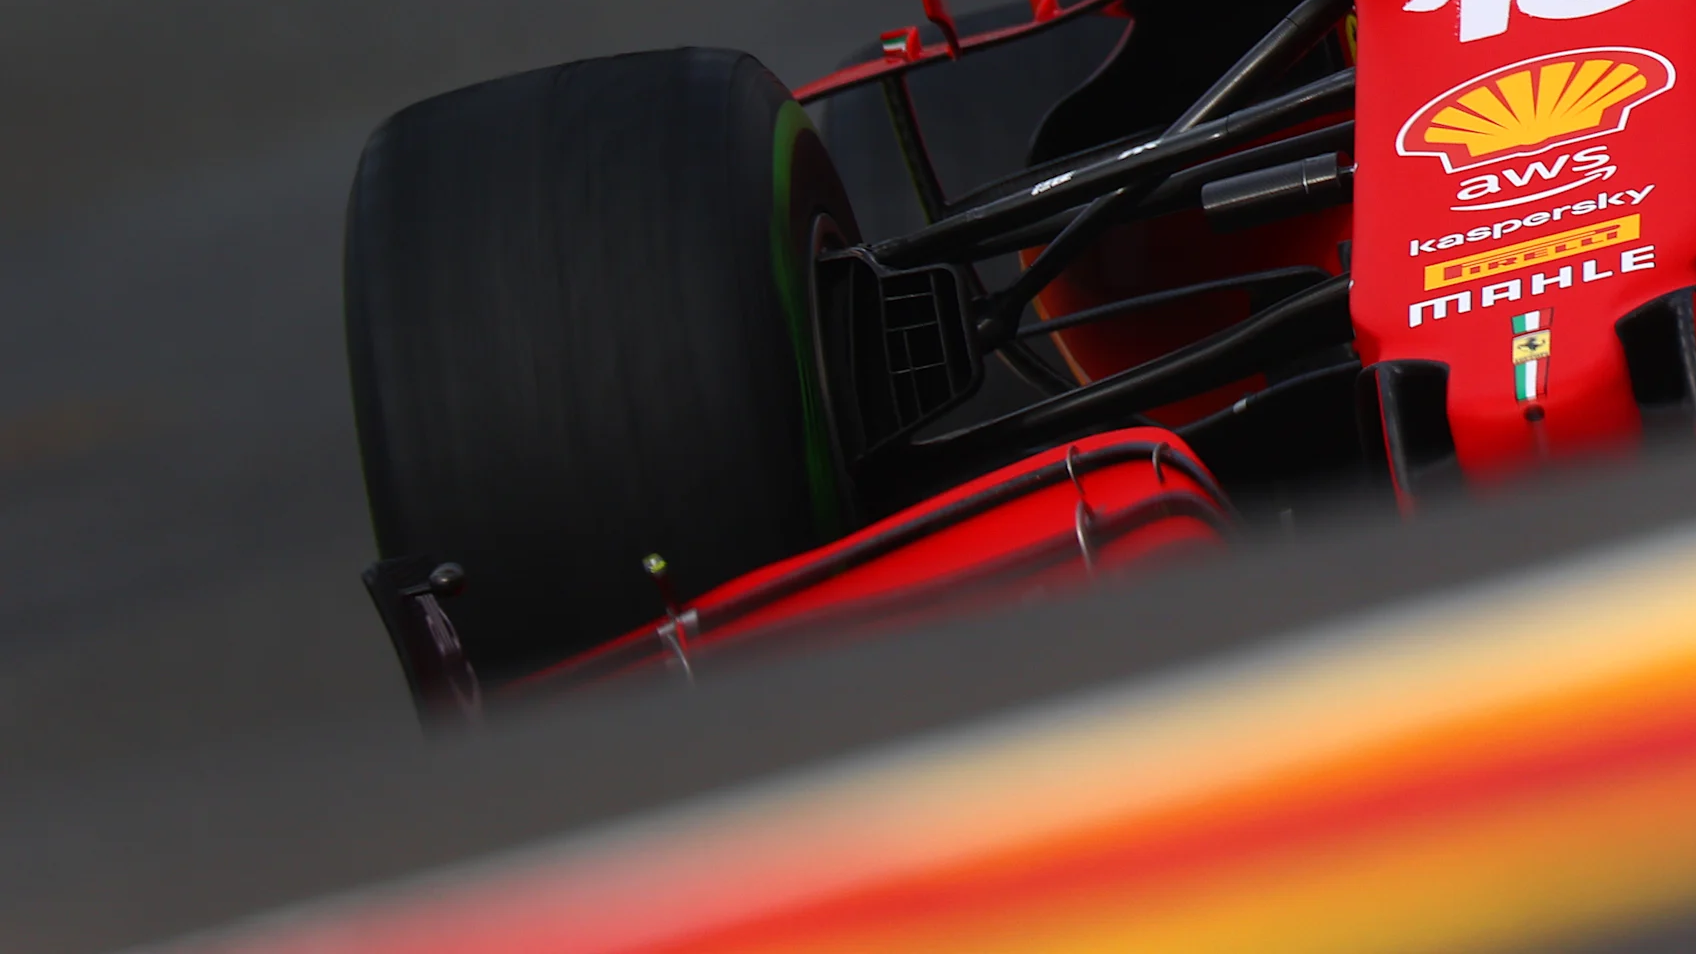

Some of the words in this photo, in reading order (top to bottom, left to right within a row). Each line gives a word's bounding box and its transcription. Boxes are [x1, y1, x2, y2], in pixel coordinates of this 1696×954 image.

[1409, 184, 1655, 256] kaspersky
[1443, 223, 1621, 281] PIRELLI
[1408, 245, 1656, 328] MAHLE
